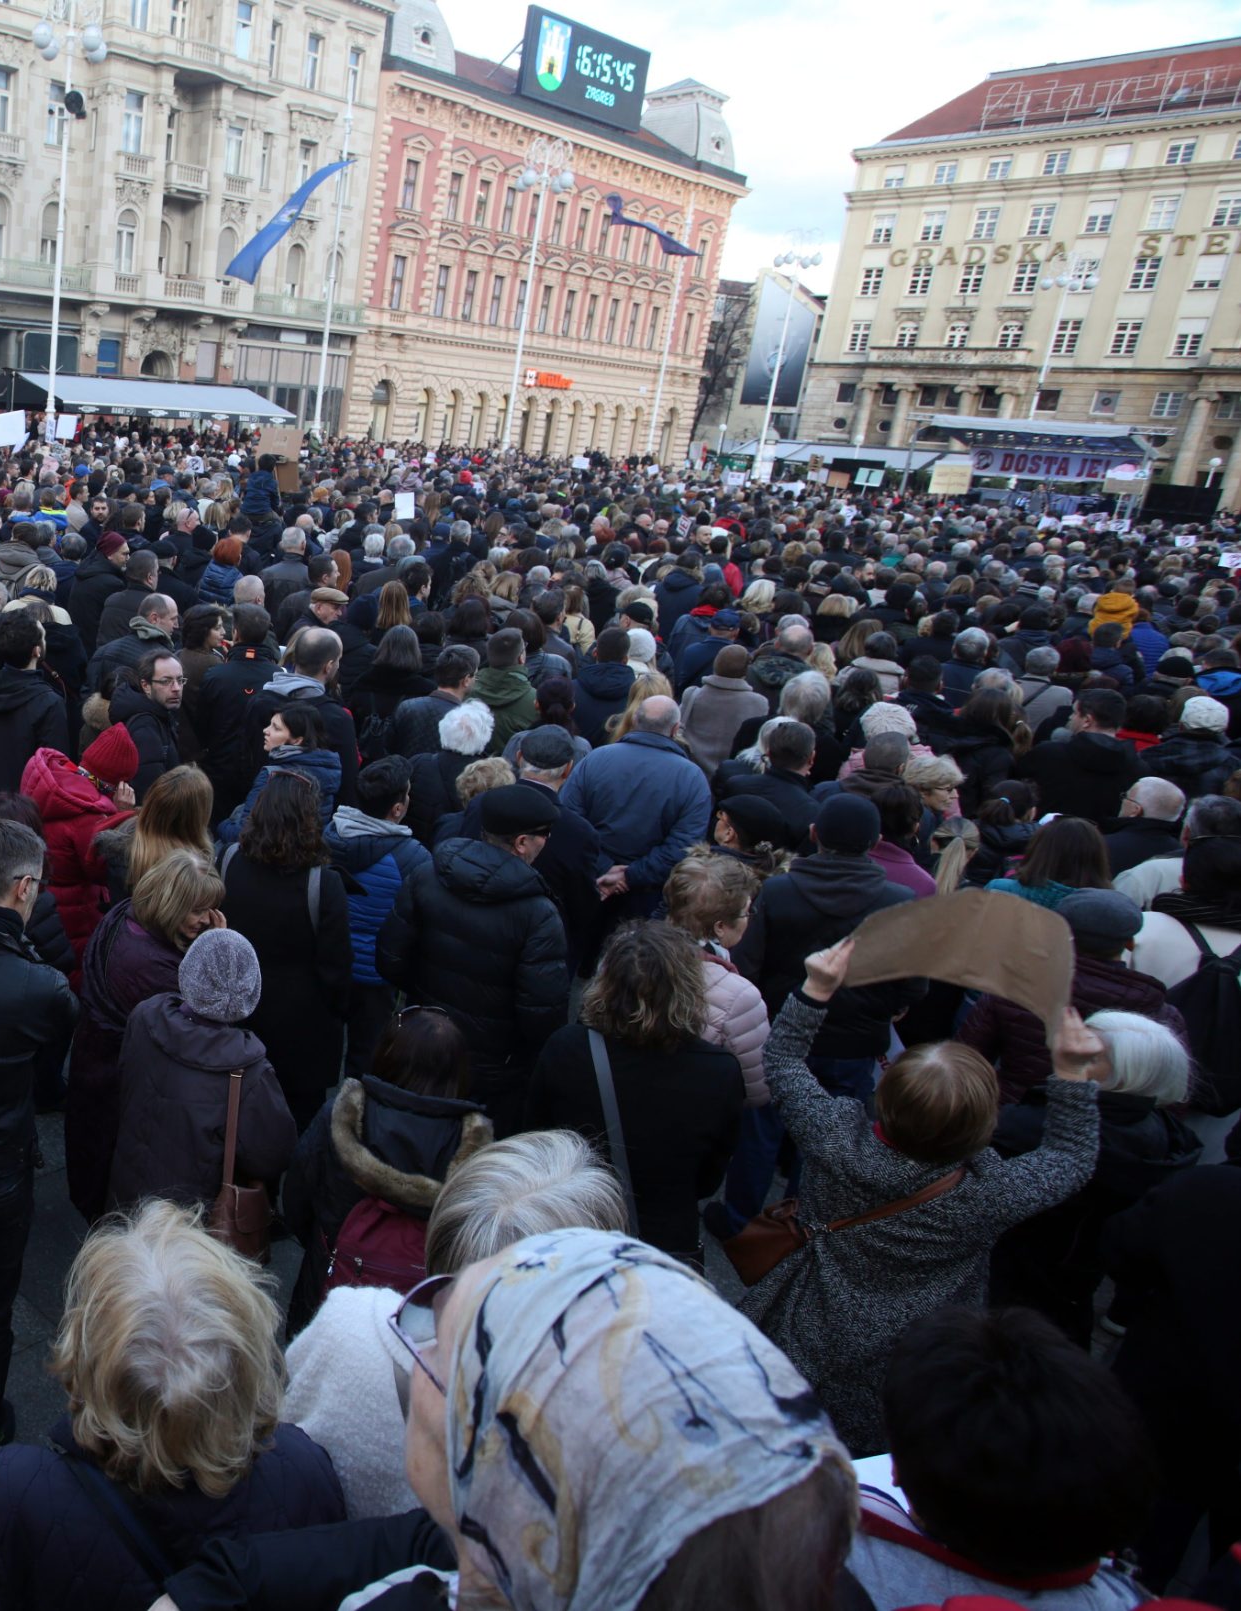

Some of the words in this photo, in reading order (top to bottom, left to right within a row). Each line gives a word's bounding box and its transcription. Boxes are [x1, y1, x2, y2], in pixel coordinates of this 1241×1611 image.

[575, 44, 636, 92] 16:15:45
[585, 85, 615, 107] ZAGREB
[889, 240, 1068, 267] GRADSKA
[999, 453, 1070, 476] DOSTA
[1076, 458, 1111, 480] JE!
